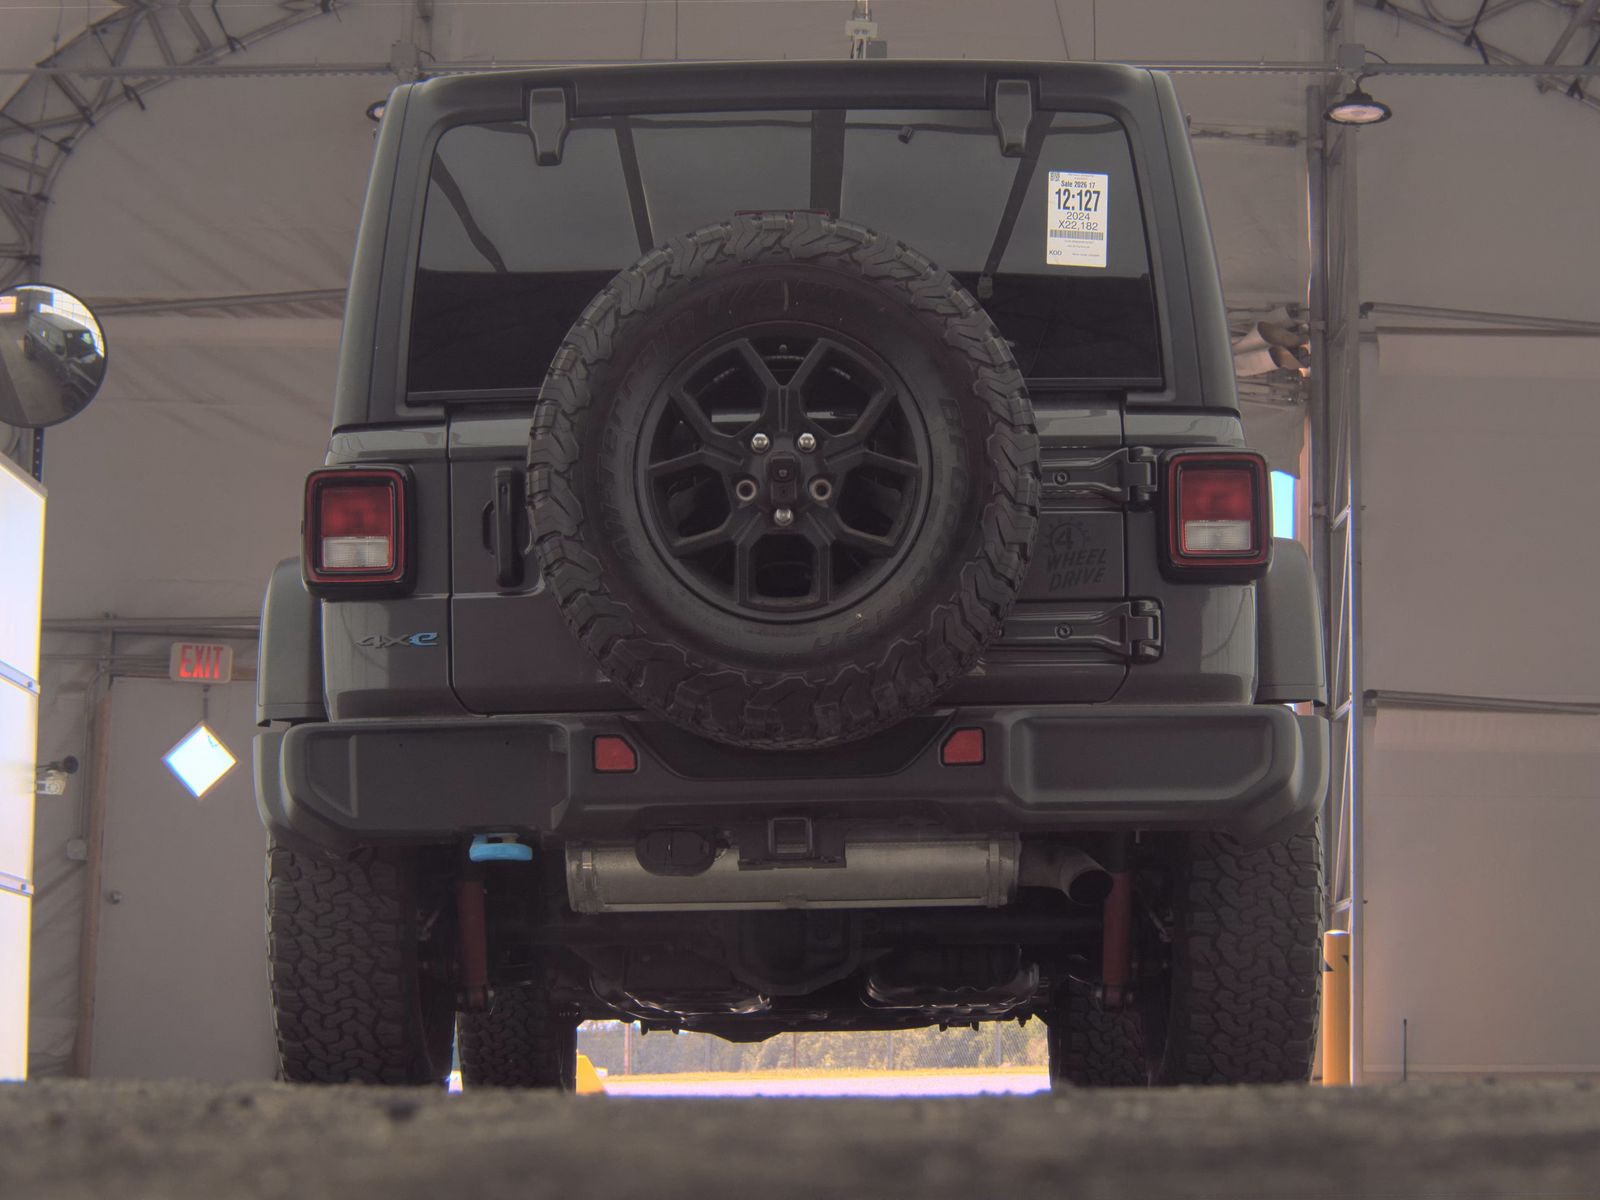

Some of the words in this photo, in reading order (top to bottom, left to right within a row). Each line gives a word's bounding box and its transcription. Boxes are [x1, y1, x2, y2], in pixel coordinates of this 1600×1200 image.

[1061, 180, 1072, 188] Sale
[1055, 188, 1101, 212] 12:127
[1058, 219, 1098, 231] X22,182
[1066, 212, 1090, 220] 2024
[1047, 548, 1107, 572] WHEEL
[1048, 567, 1107, 593] DRIVE
[179, 644, 223, 680] EXIT
